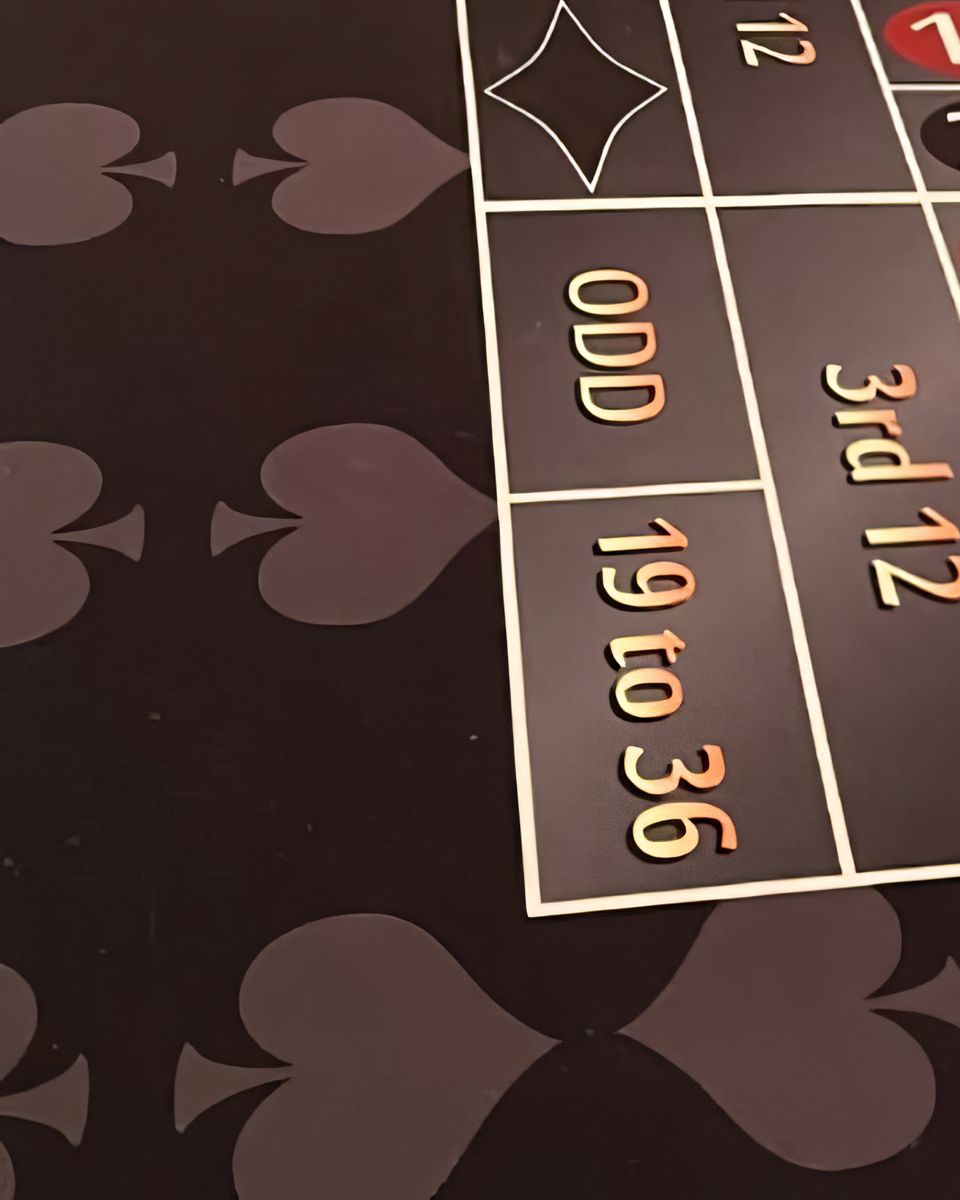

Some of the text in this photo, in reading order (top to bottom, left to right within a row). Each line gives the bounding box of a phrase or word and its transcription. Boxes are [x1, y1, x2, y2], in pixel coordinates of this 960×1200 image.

[736, 12, 816, 67] 12
[569, 270, 665, 421] ODD
[824, 364, 954, 482] 3rd
[598, 517, 738, 858] 19 to 36
